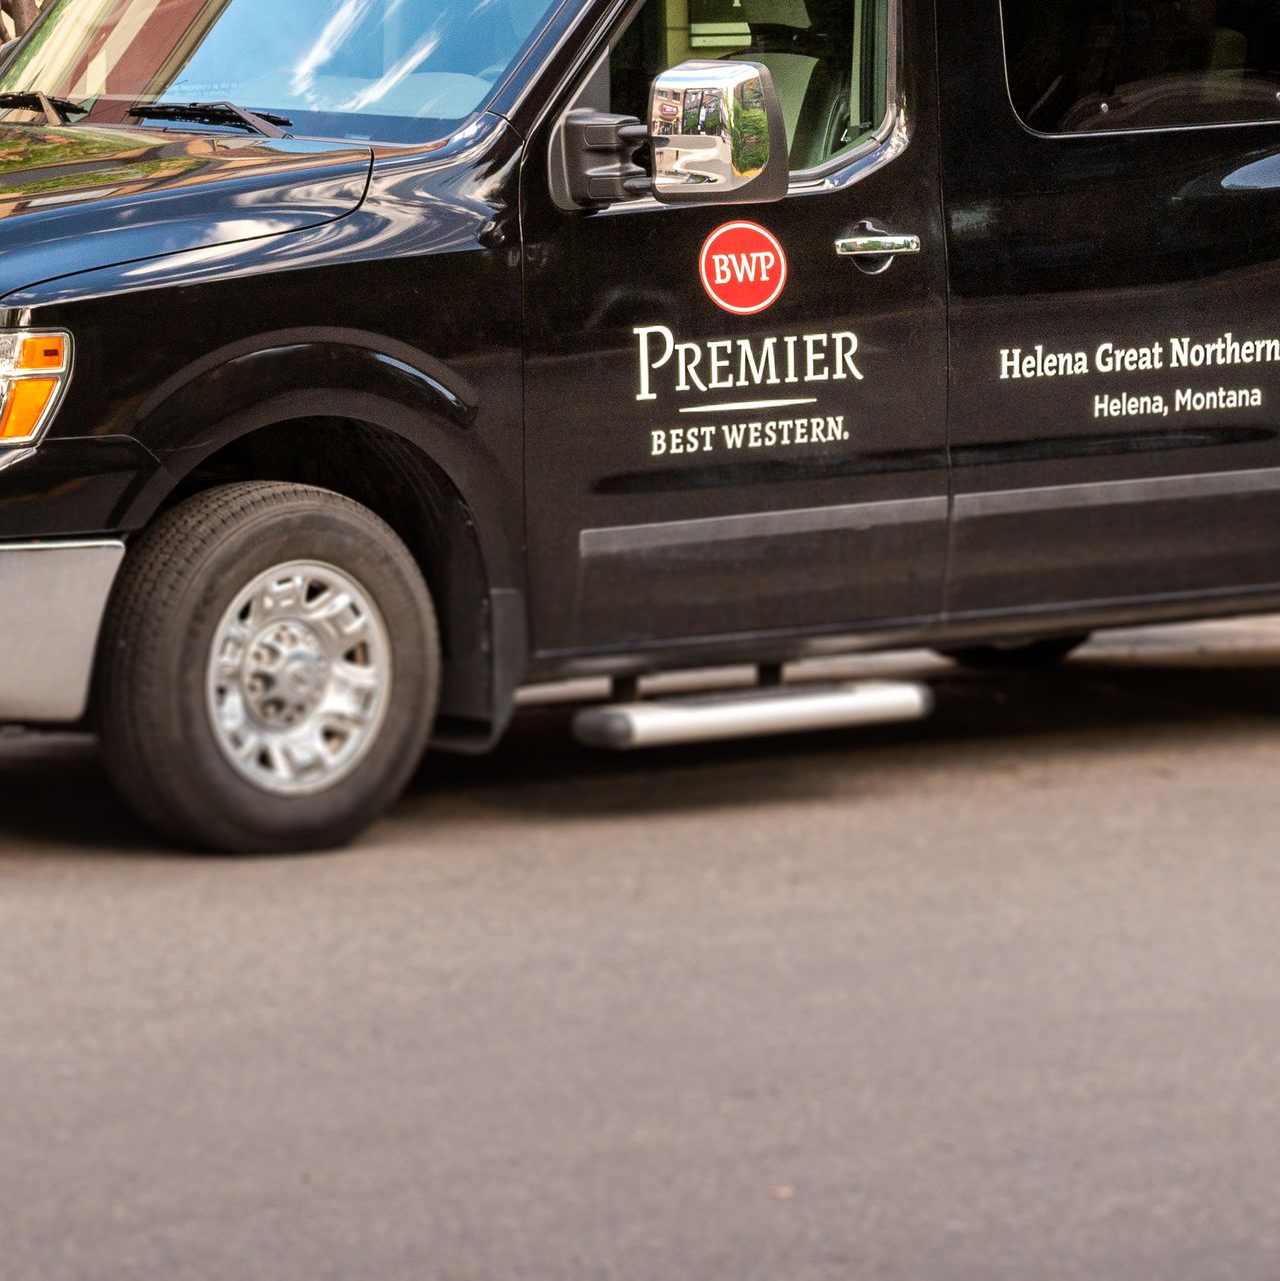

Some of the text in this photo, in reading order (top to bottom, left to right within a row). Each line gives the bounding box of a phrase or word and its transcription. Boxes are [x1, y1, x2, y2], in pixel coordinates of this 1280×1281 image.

[712, 251, 776, 284] BWP
[633, 325, 864, 401] PREMIER
[999, 345, 1089, 380] Helena
[1095, 341, 1163, 373] Great
[1169, 332, 1280, 369] Northern
[1094, 387, 1262, 418] Helena, Montana
[651, 426, 716, 455] BEST
